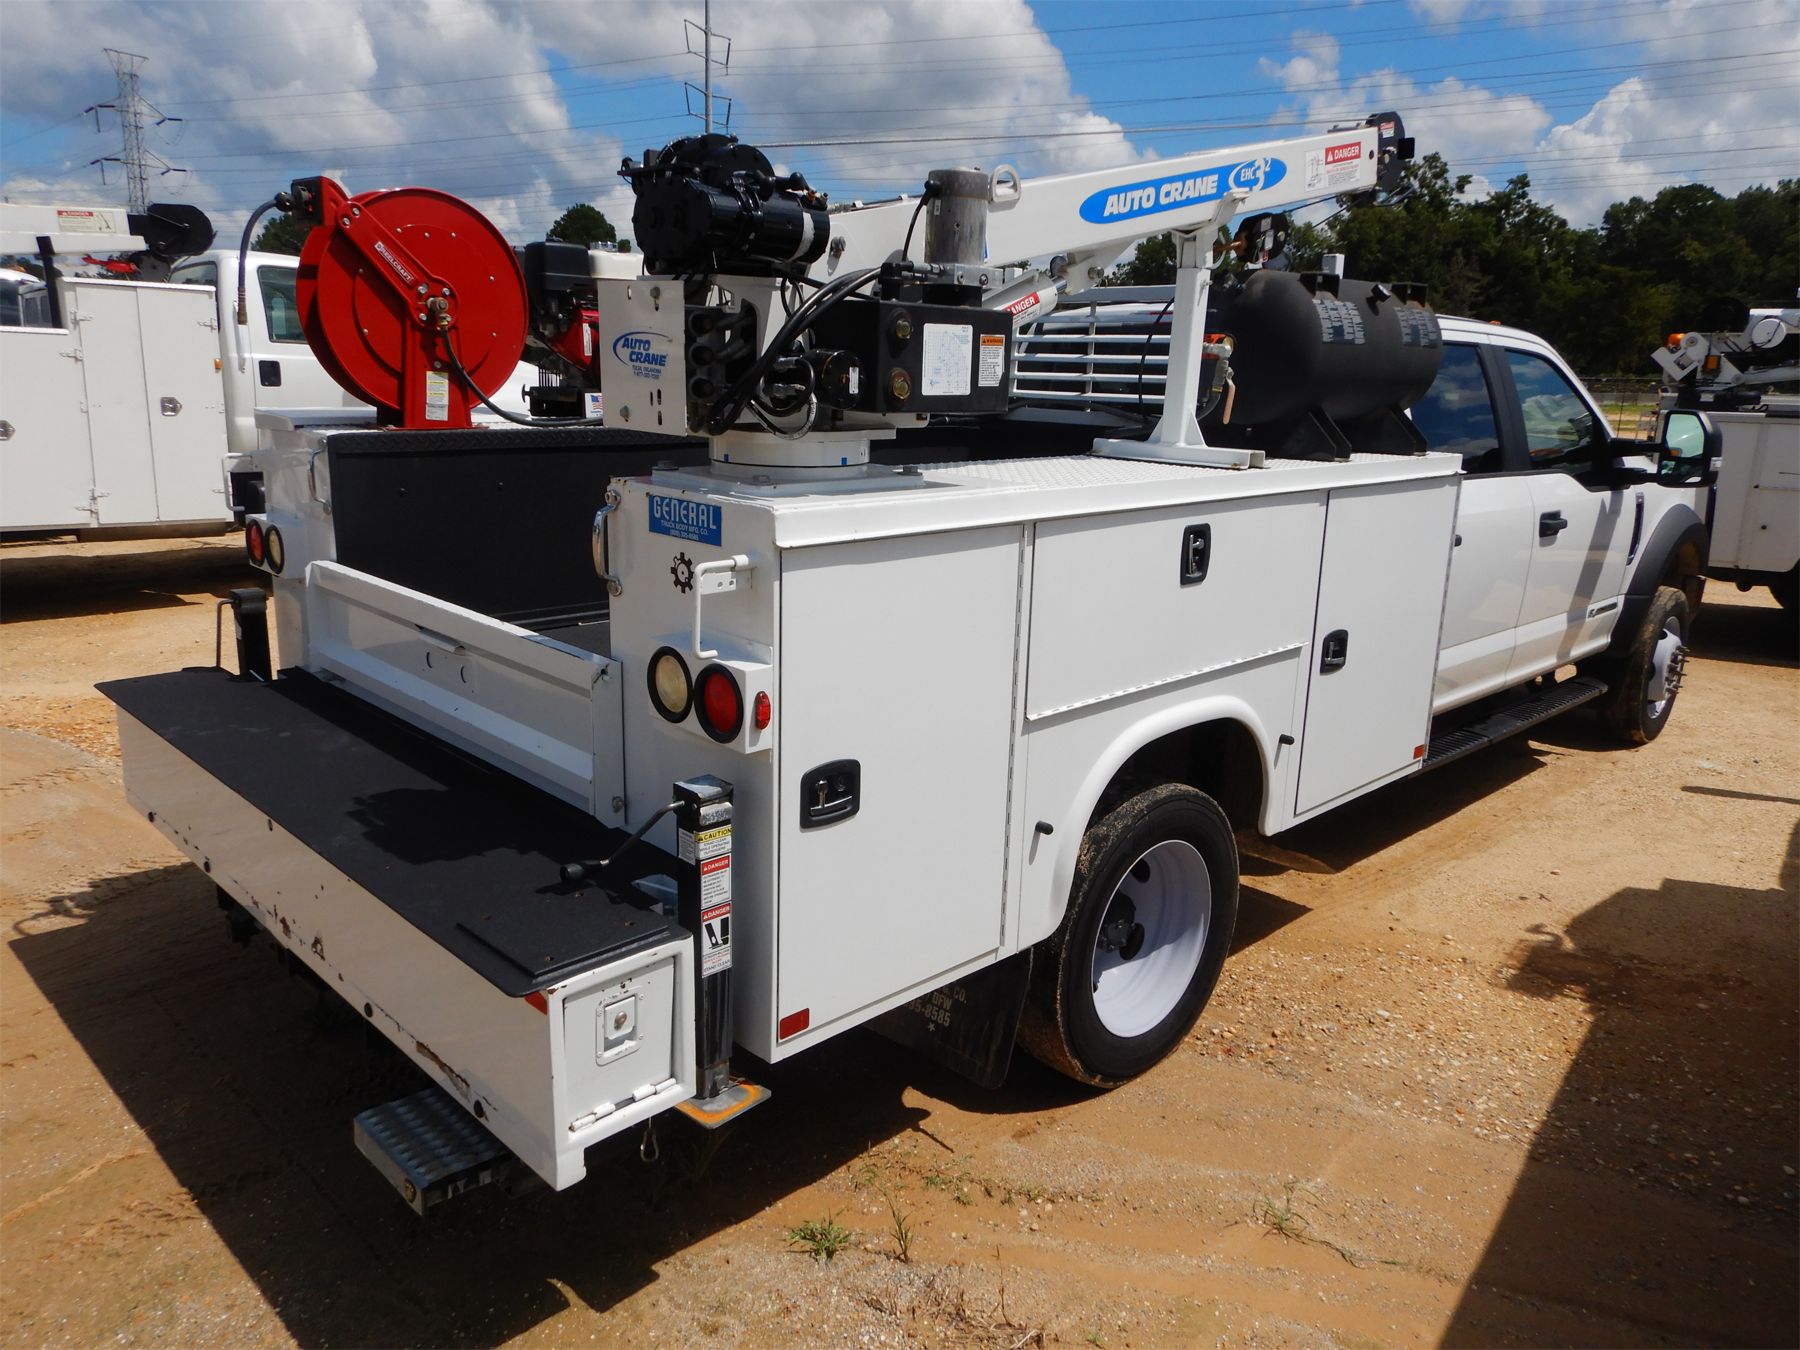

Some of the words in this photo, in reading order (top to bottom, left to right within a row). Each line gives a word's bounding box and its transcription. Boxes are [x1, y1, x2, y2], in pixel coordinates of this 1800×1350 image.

[1334, 146, 1360, 161] DANGER
[1103, 187, 1155, 217] AUTO
[1159, 174, 1218, 205] CRANE
[622, 337, 651, 351] AUTO
[629, 351, 666, 366] CRANE
[653, 496, 717, 530] GENERAL
[661, 520, 675, 529] TRUCK
[676, 524, 688, 532] BODY
[704, 828, 732, 841] CAUTION
[708, 859, 728, 871] DANGER
[707, 905, 730, 918] DANGER
